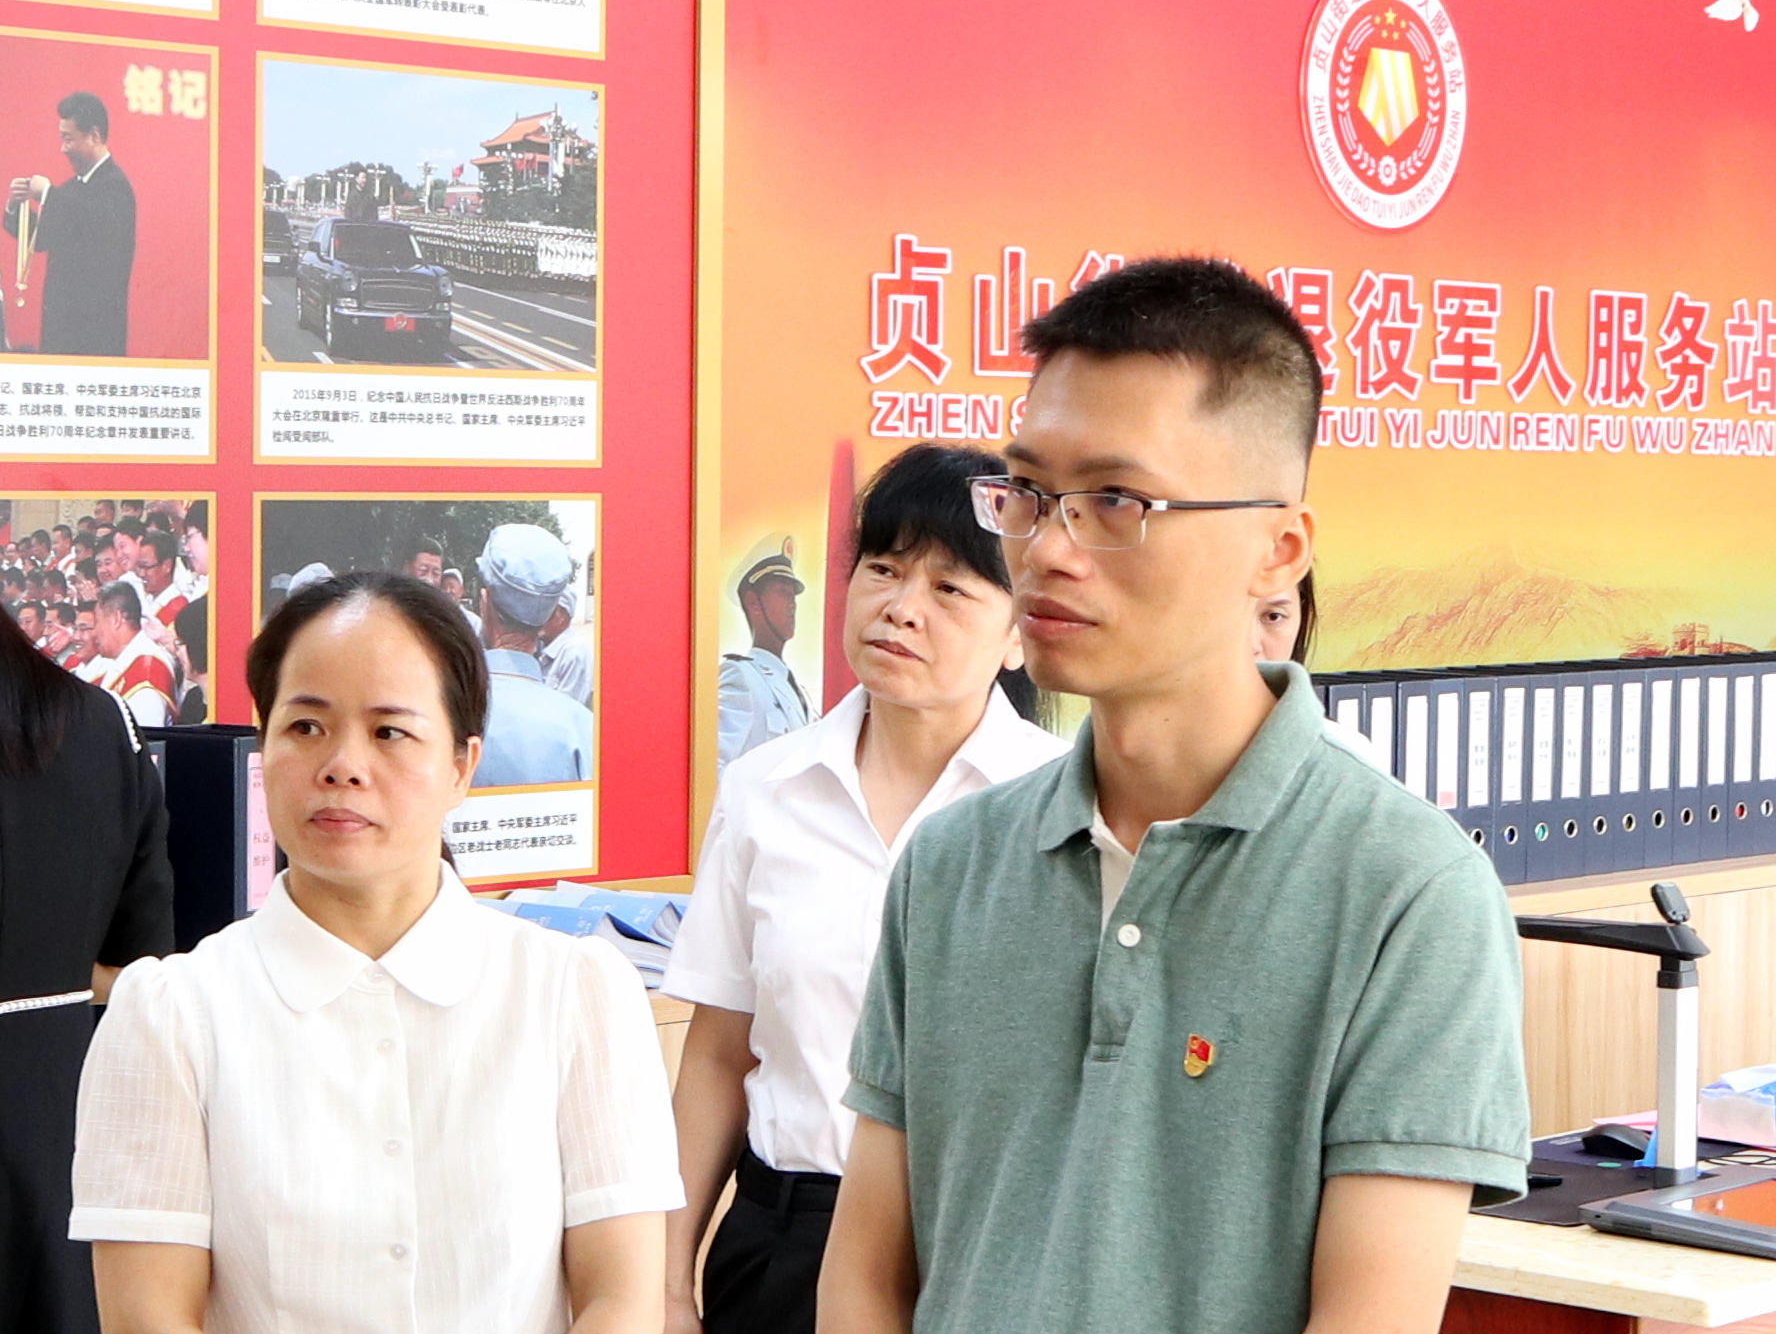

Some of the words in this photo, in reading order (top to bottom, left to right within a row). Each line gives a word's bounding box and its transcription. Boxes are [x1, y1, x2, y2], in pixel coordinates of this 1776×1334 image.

[123, 64, 208, 120] 铭记
[870, 391, 1003, 439] ZHEN
[1385, 408, 1423, 449] YI
[1426, 409, 1504, 450] JUN
[1509, 412, 1579, 452] REN
[1583, 414, 1626, 453] FU
[1632, 416, 1689, 454] WU
